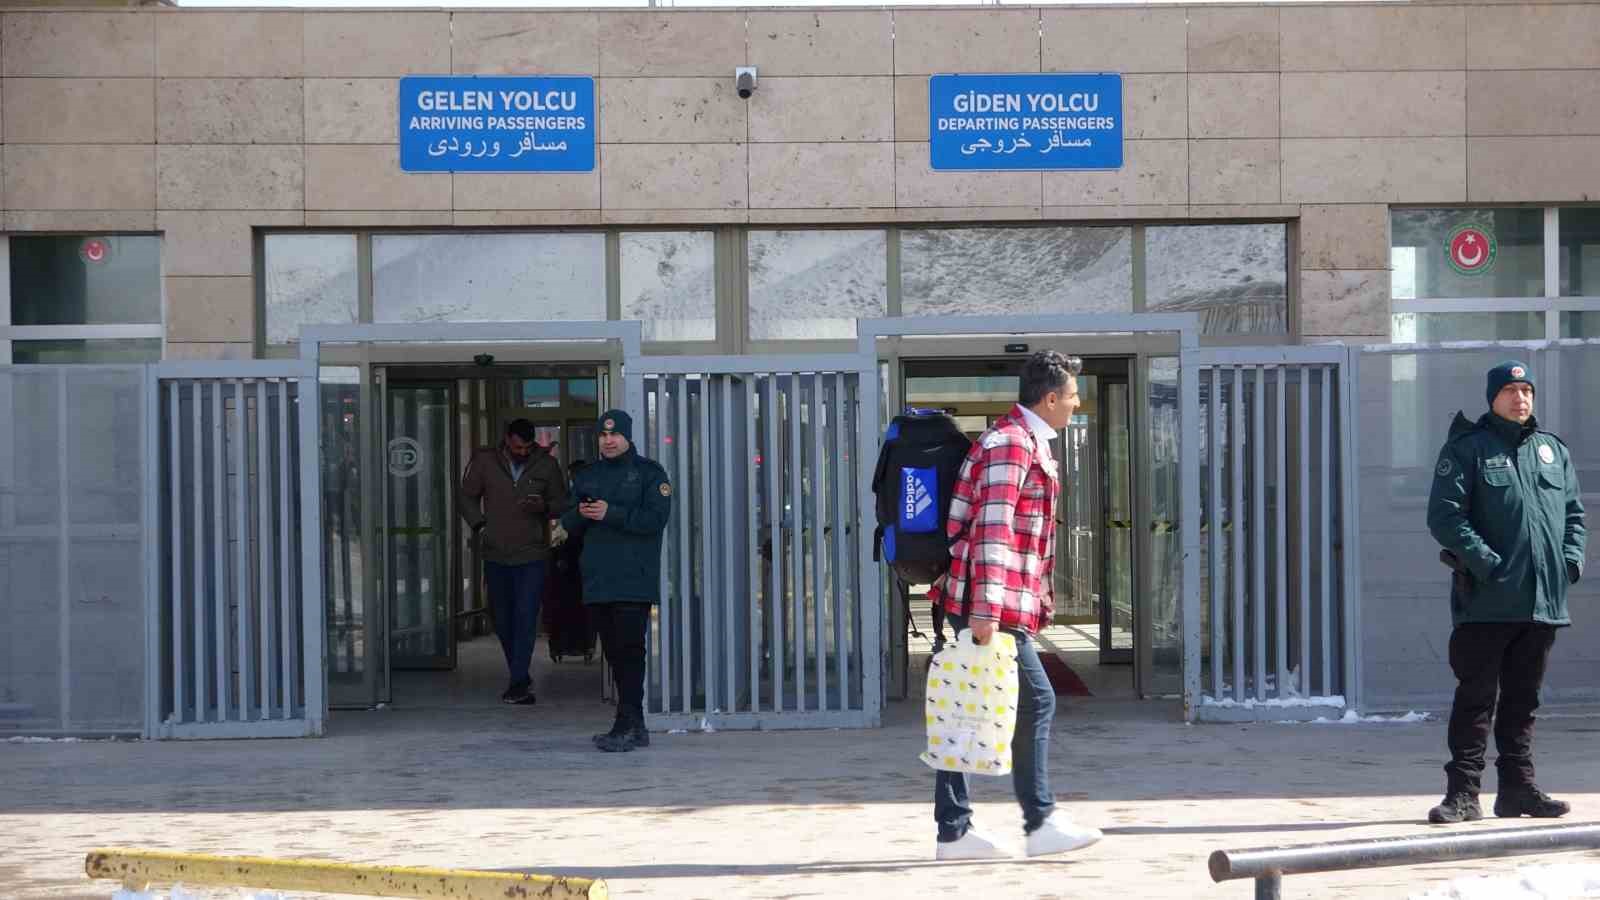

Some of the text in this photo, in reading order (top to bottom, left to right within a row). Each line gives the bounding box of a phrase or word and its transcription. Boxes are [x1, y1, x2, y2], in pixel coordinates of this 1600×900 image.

[417, 91, 577, 111] GELEN YOLCU
[953, 90, 1098, 112] GİDEN YOLCU
[409, 116, 586, 130] ARRIVING PASSENGERS
[938, 117, 1115, 130] DEPARTING PASSENGERS
[428, 131, 568, 157] مسافر ورودی
[961, 130, 1092, 155] مسافر خروجی
[906, 476, 916, 520] adidas
